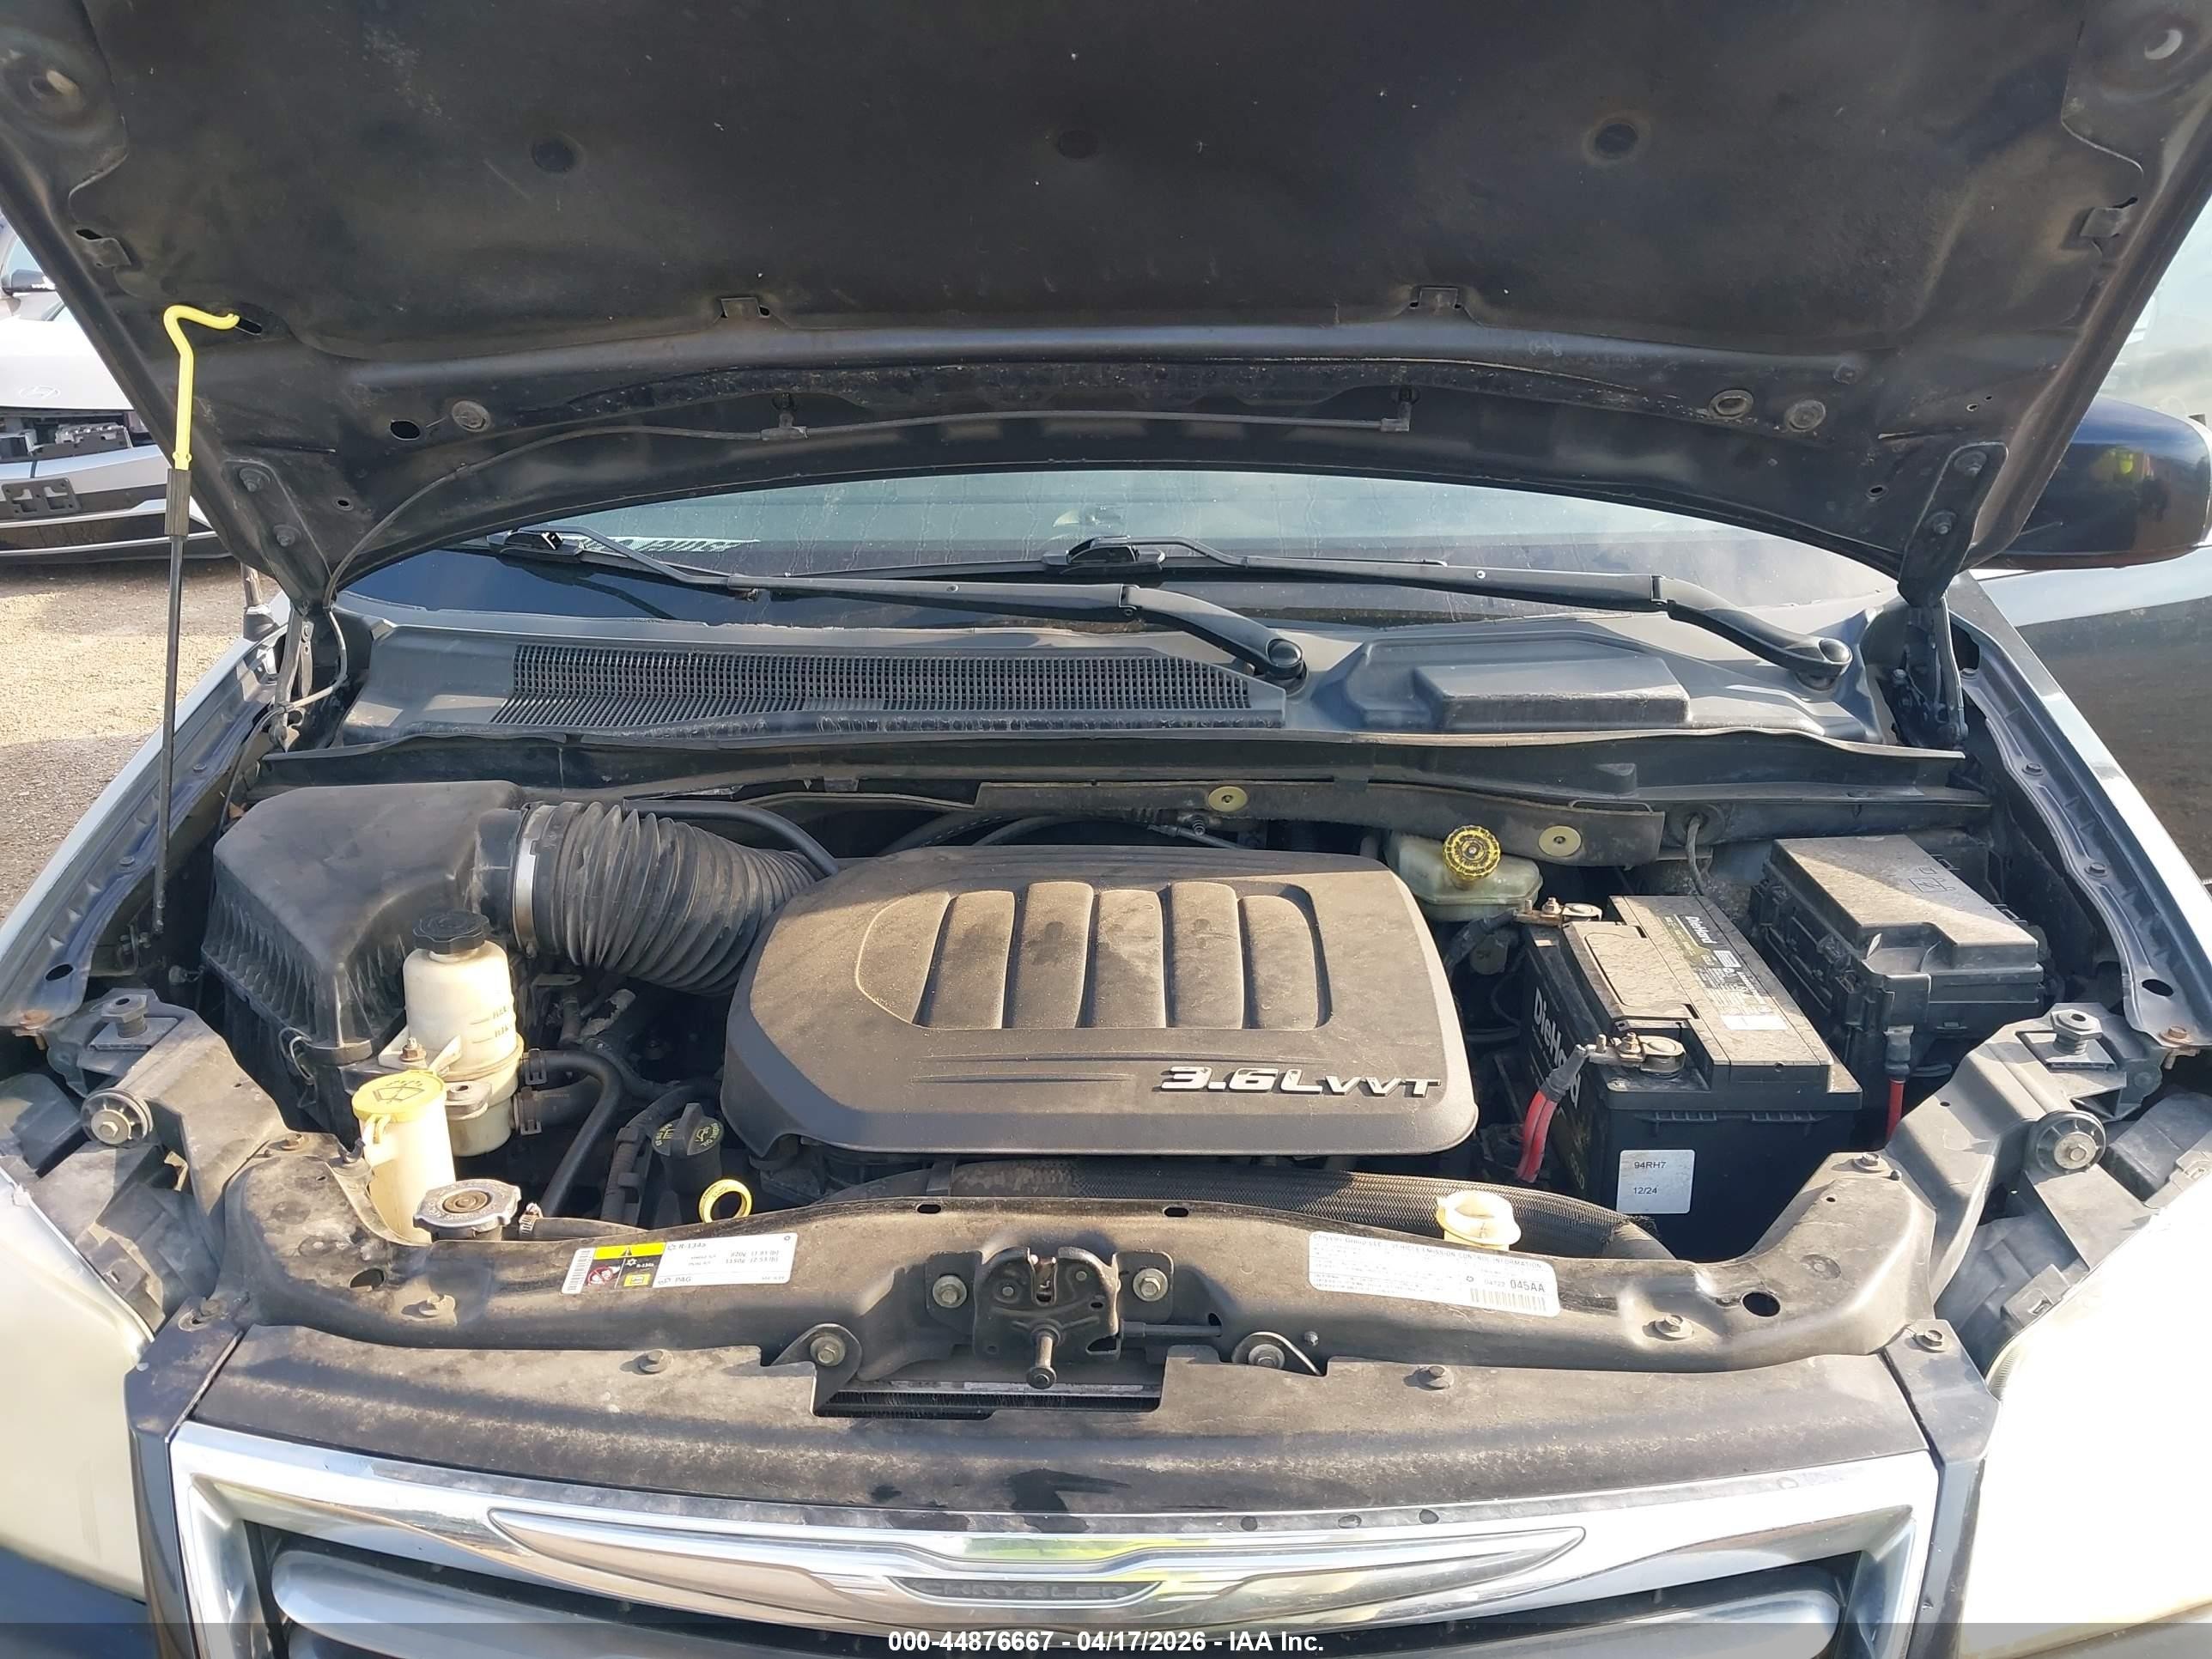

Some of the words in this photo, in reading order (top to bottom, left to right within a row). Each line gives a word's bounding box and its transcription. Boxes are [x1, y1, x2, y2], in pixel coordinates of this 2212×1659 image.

[1685, 915, 1718, 945] DieHard
[1534, 987, 1581, 1109] DieHad
[1160, 1066, 1323, 1095] 3.6L
[1325, 1075, 1441, 1098] VVT
[1633, 1161, 1668, 1170] 94RH7
[1510, 1279, 1546, 1293] 045AA
